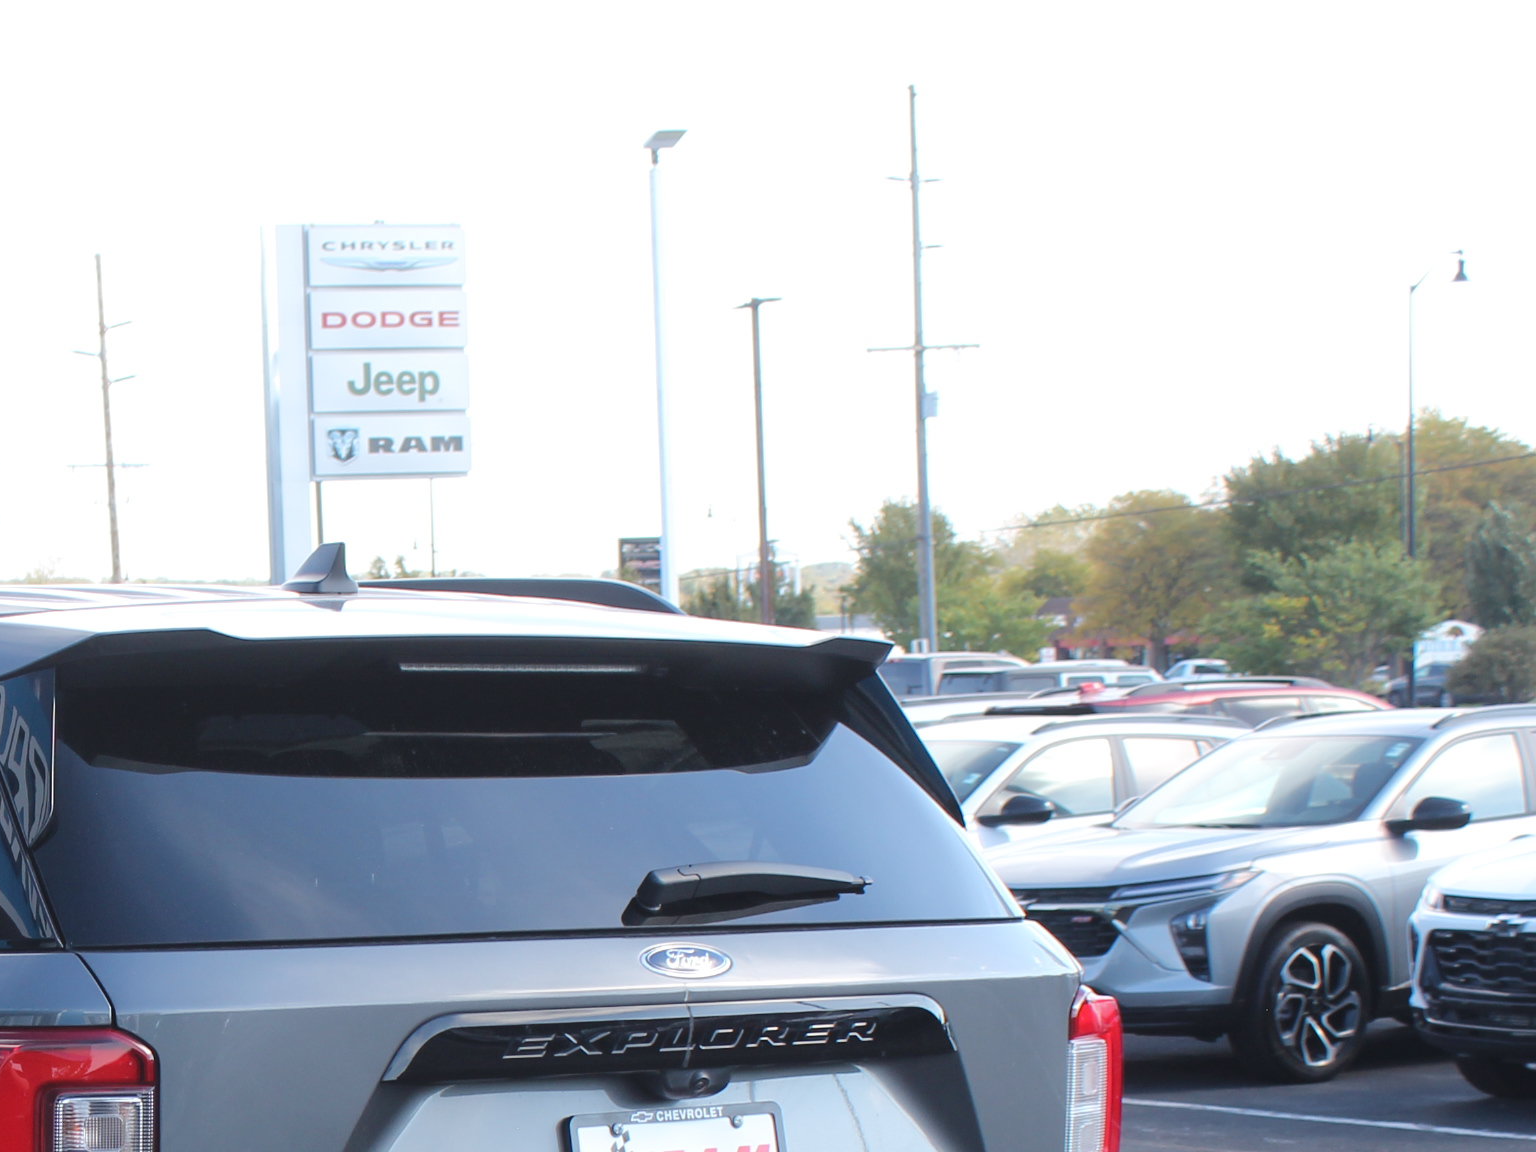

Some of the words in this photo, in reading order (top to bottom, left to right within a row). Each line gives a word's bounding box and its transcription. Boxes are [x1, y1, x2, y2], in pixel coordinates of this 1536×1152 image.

[321, 240, 455, 252] CHRYSLER
[321, 311, 460, 329] DODGE
[347, 362, 440, 402] Jeep
[368, 435, 463, 454] RAM
[502, 1021, 878, 1060] EXPLORER
[656, 1106, 724, 1122] CHEVROLET
